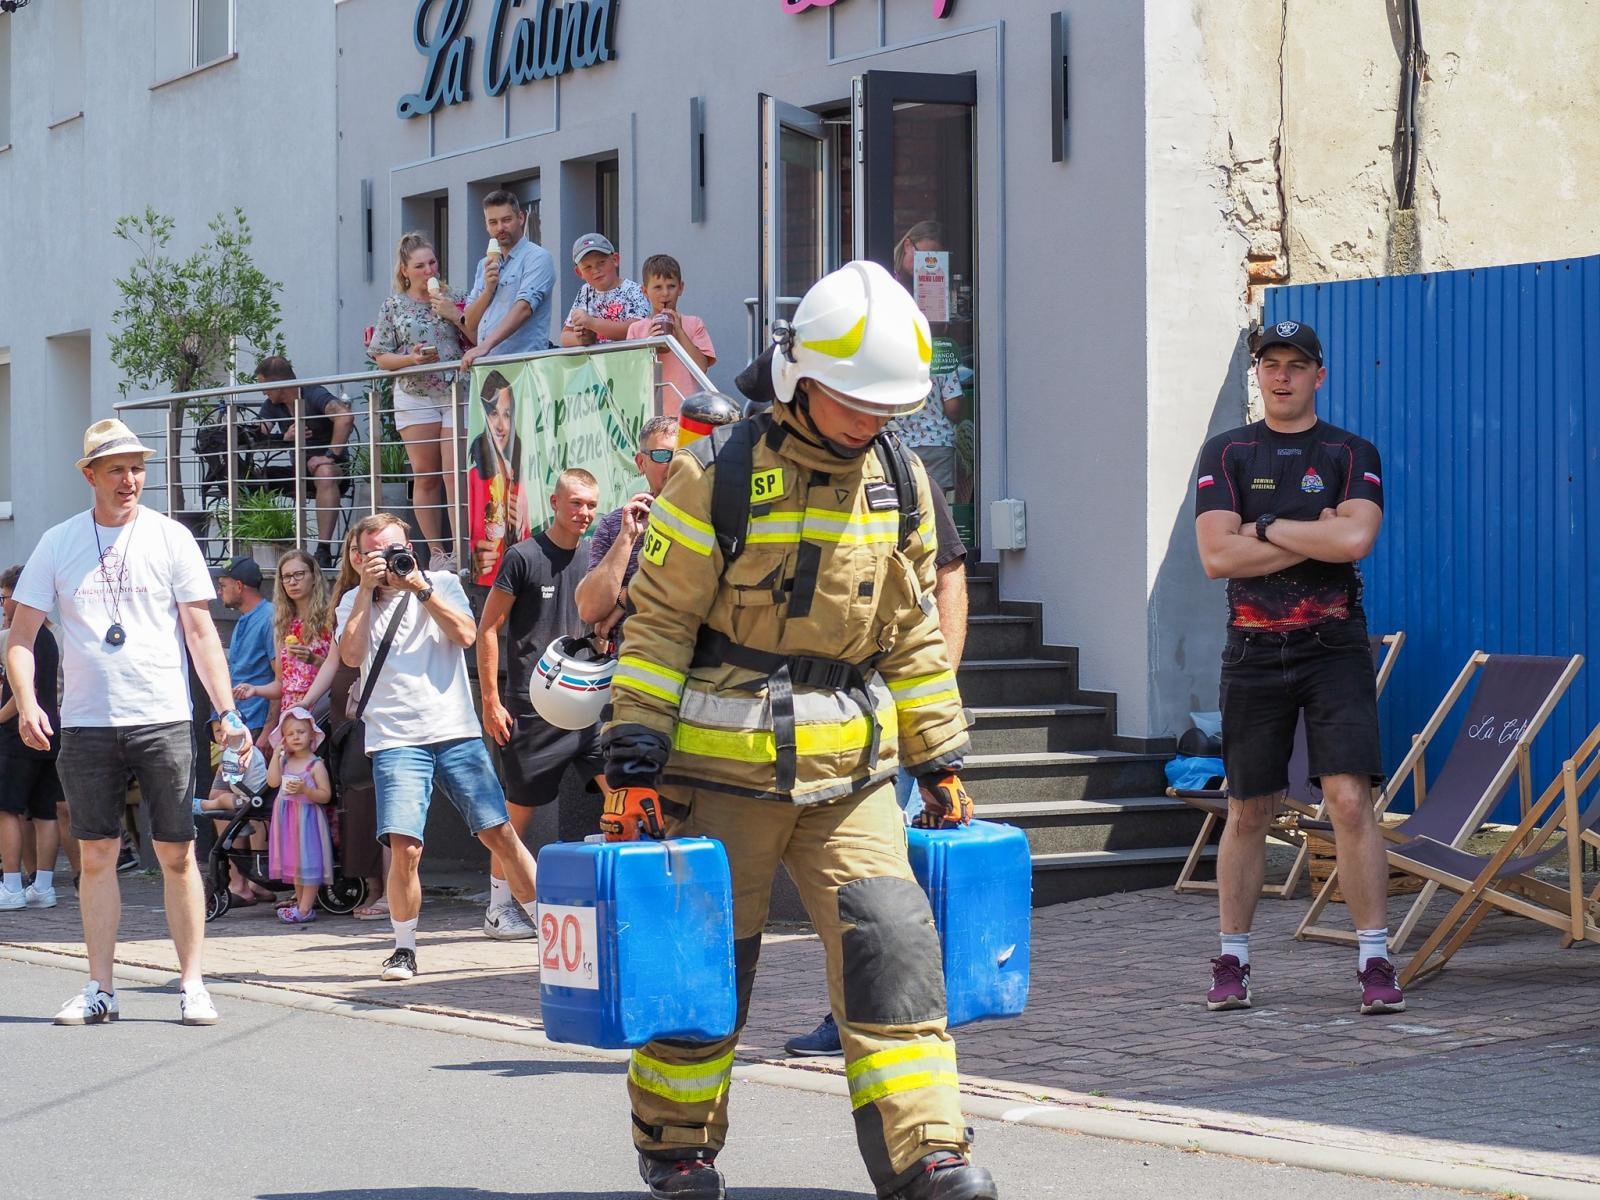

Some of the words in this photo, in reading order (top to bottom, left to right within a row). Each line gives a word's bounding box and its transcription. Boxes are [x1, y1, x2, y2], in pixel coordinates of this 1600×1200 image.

[396, 0, 473, 119] La
[483, 0, 618, 97] Colina
[750, 474, 776, 496] SP
[1468, 715, 1495, 741] La
[541, 912, 582, 973] 20
[582, 951, 593, 981] kg
